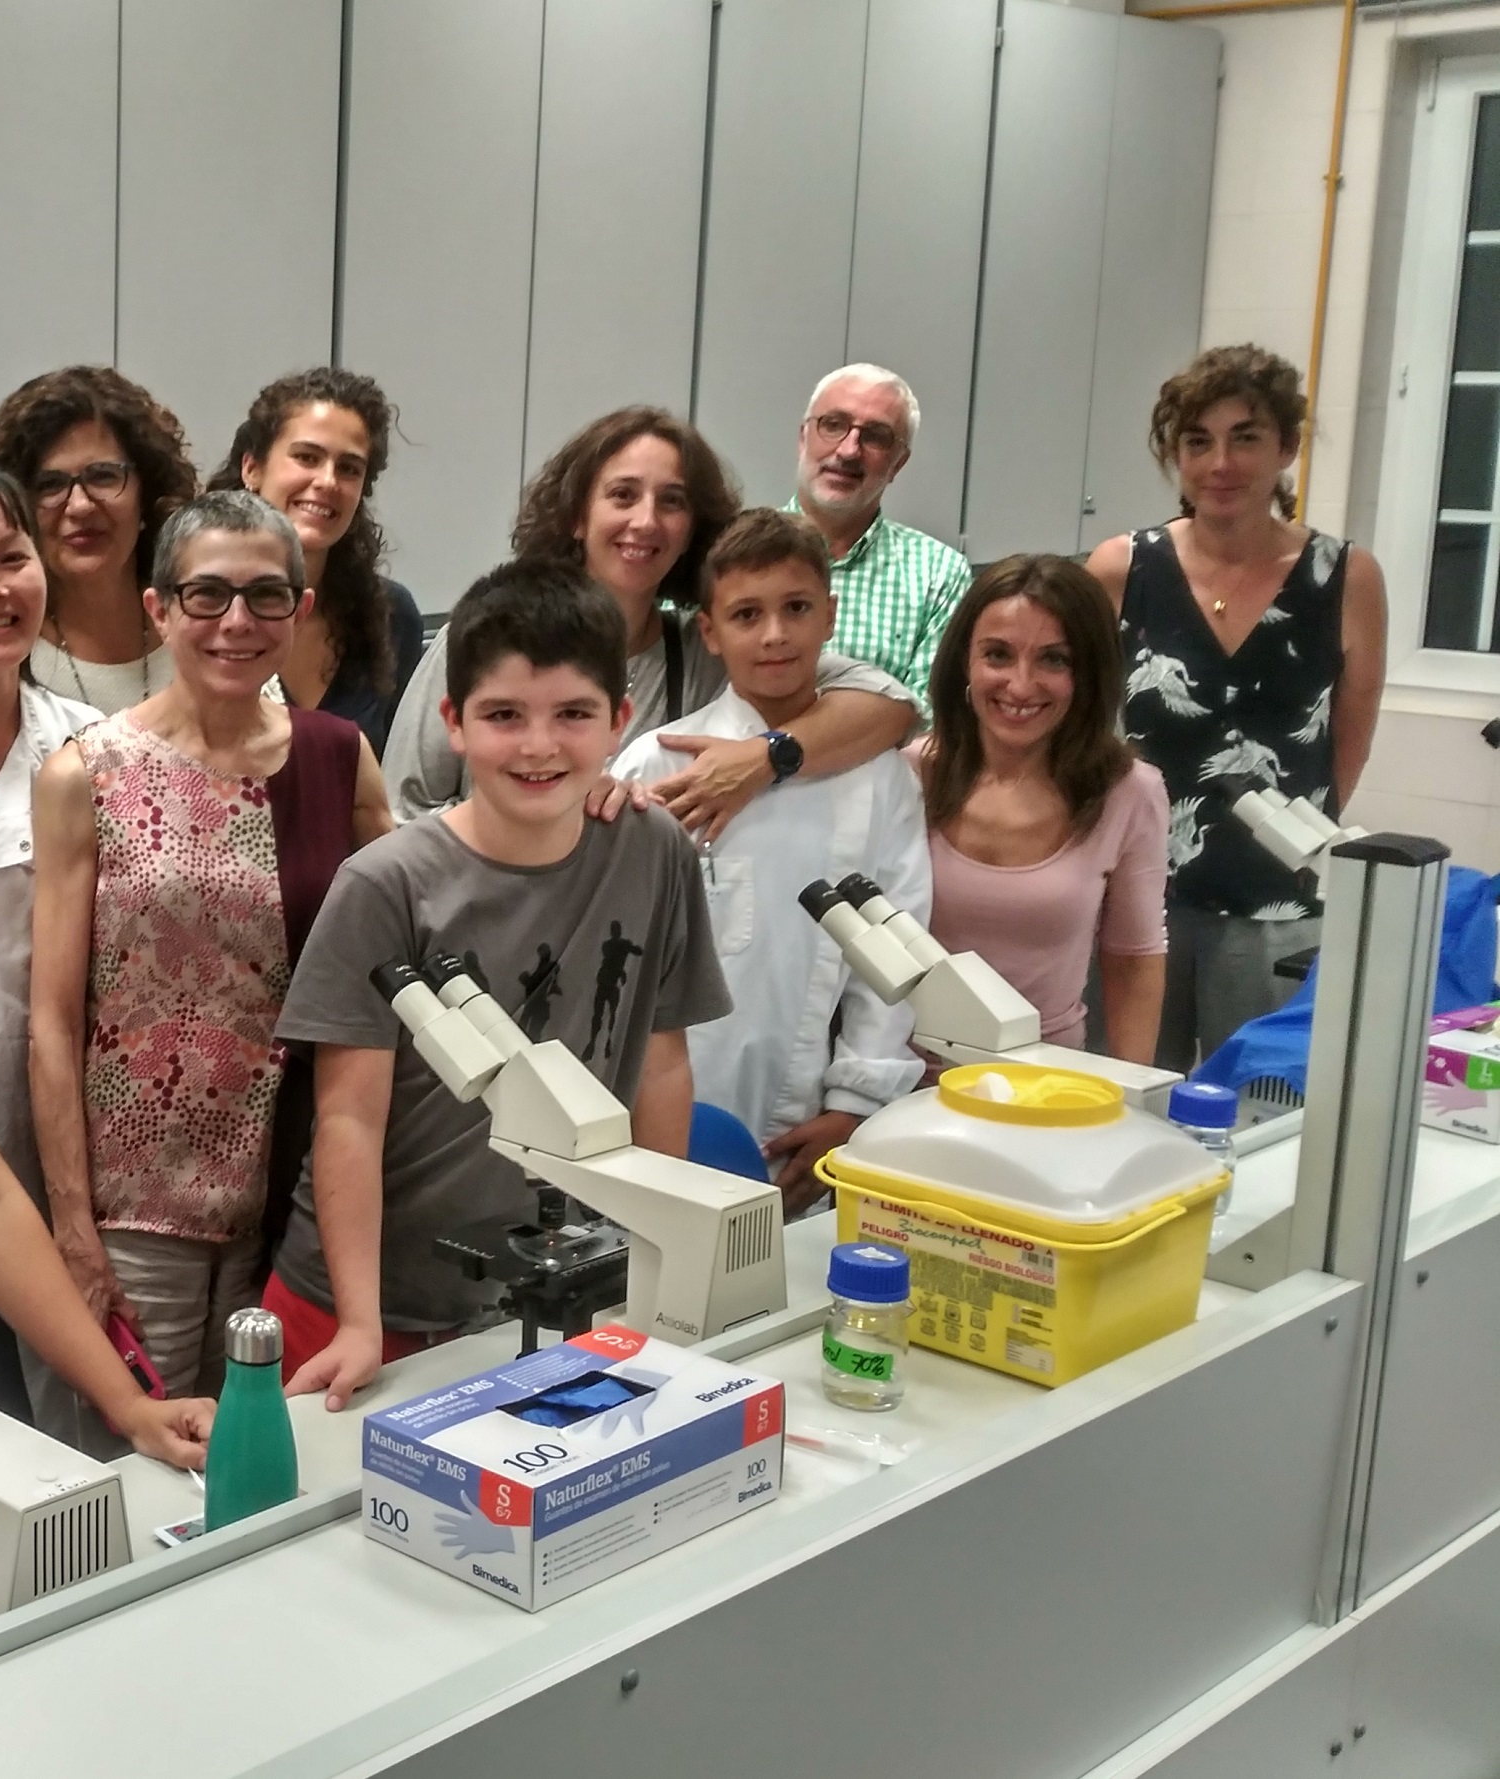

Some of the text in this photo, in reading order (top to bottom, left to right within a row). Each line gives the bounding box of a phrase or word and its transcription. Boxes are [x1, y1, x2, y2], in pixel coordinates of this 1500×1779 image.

[861, 1221, 910, 1242] PELIGRO
[968, 1252, 1002, 1270] RIESGO
[593, 1332, 624, 1346] S
[851, 1353, 887, 1377] 70%
[457, 1379, 495, 1396] EMS
[694, 1377, 755, 1403] Bimedica
[758, 1399, 769, 1422] S
[436, 1456, 468, 1482] EMS
[502, 1443, 569, 1474] 100
[620, 1450, 651, 1479] EMS
[745, 1458, 767, 1480] 100
[496, 1484, 512, 1508] S
[738, 1480, 773, 1504] Bimedica
[370, 1497, 410, 1533] 100
[471, 1562, 519, 1595] Bimedica
